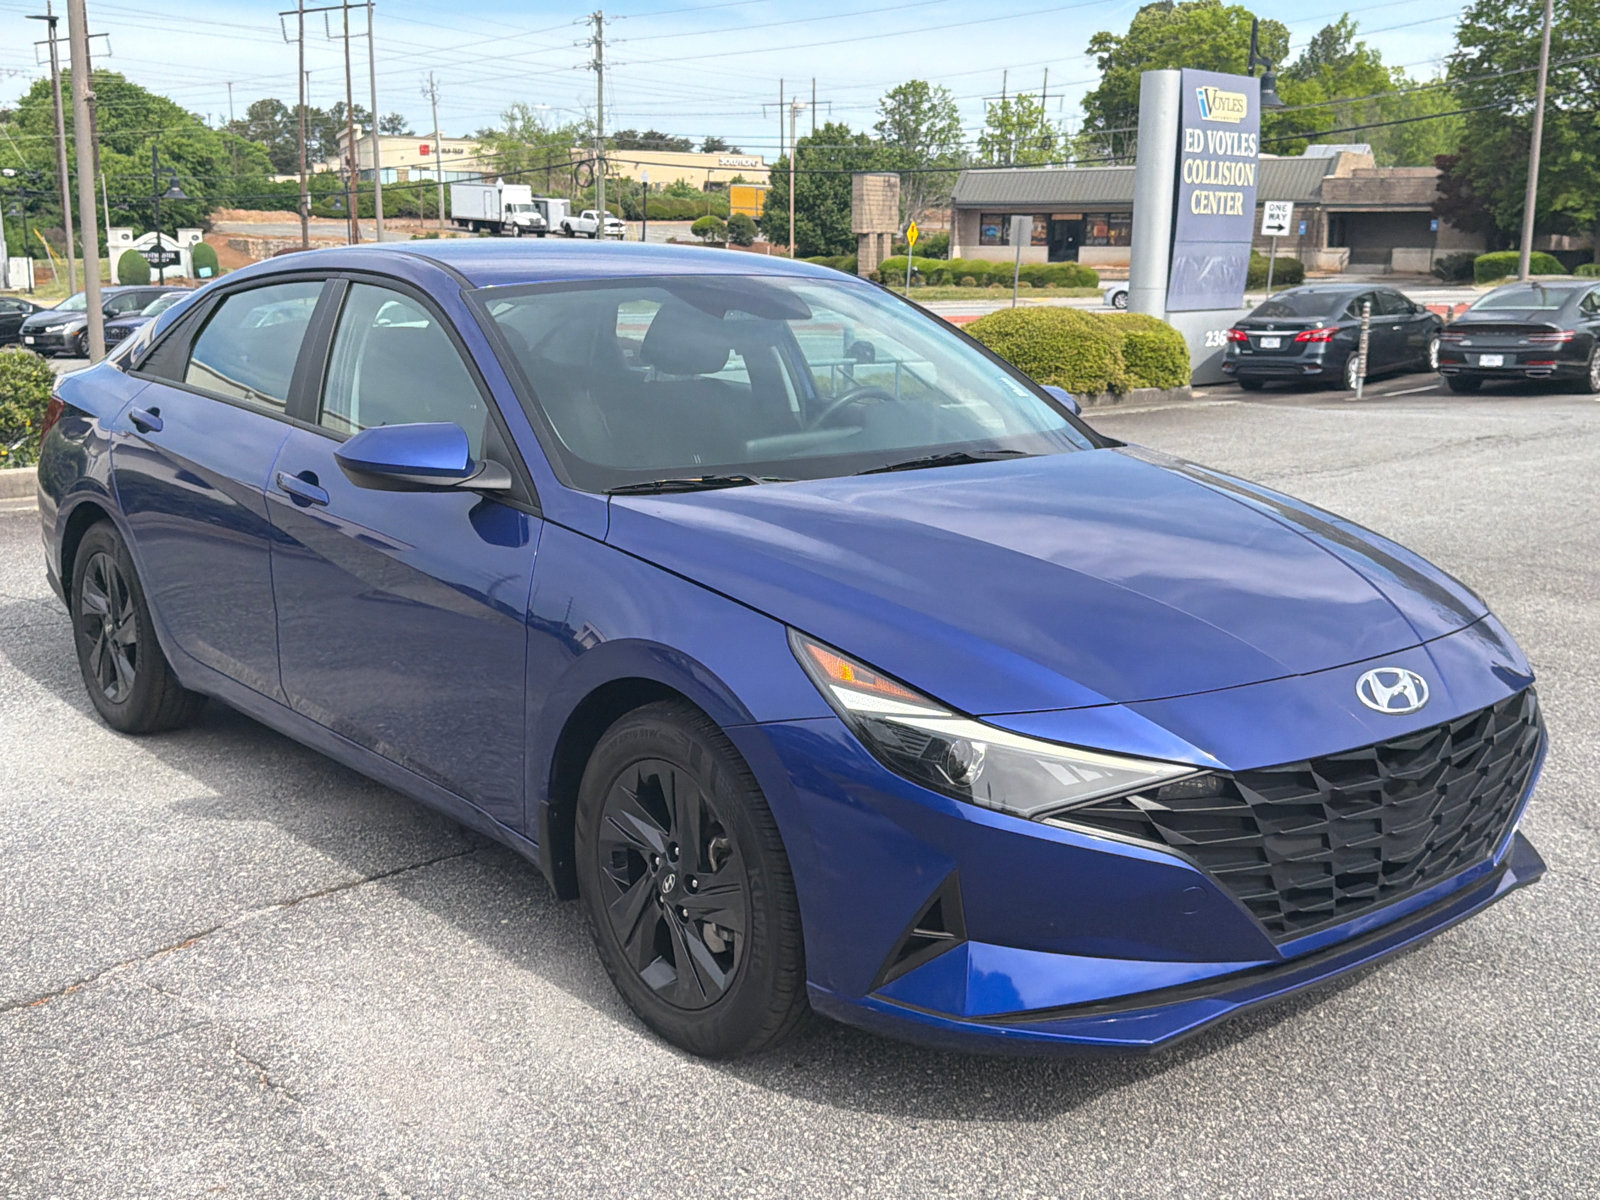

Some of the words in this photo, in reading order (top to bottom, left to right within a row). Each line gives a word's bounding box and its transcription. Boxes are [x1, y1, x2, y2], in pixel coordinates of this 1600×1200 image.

[1204, 88, 1244, 115] VOYLES
[1184, 128, 1204, 153] ED
[1207, 130, 1257, 157] VOYLES
[1184, 158, 1256, 186] COLLISION
[1191, 189, 1244, 216] CENTER
[1269, 203, 1288, 212] ONE
[1268, 213, 1288, 221] WAY
